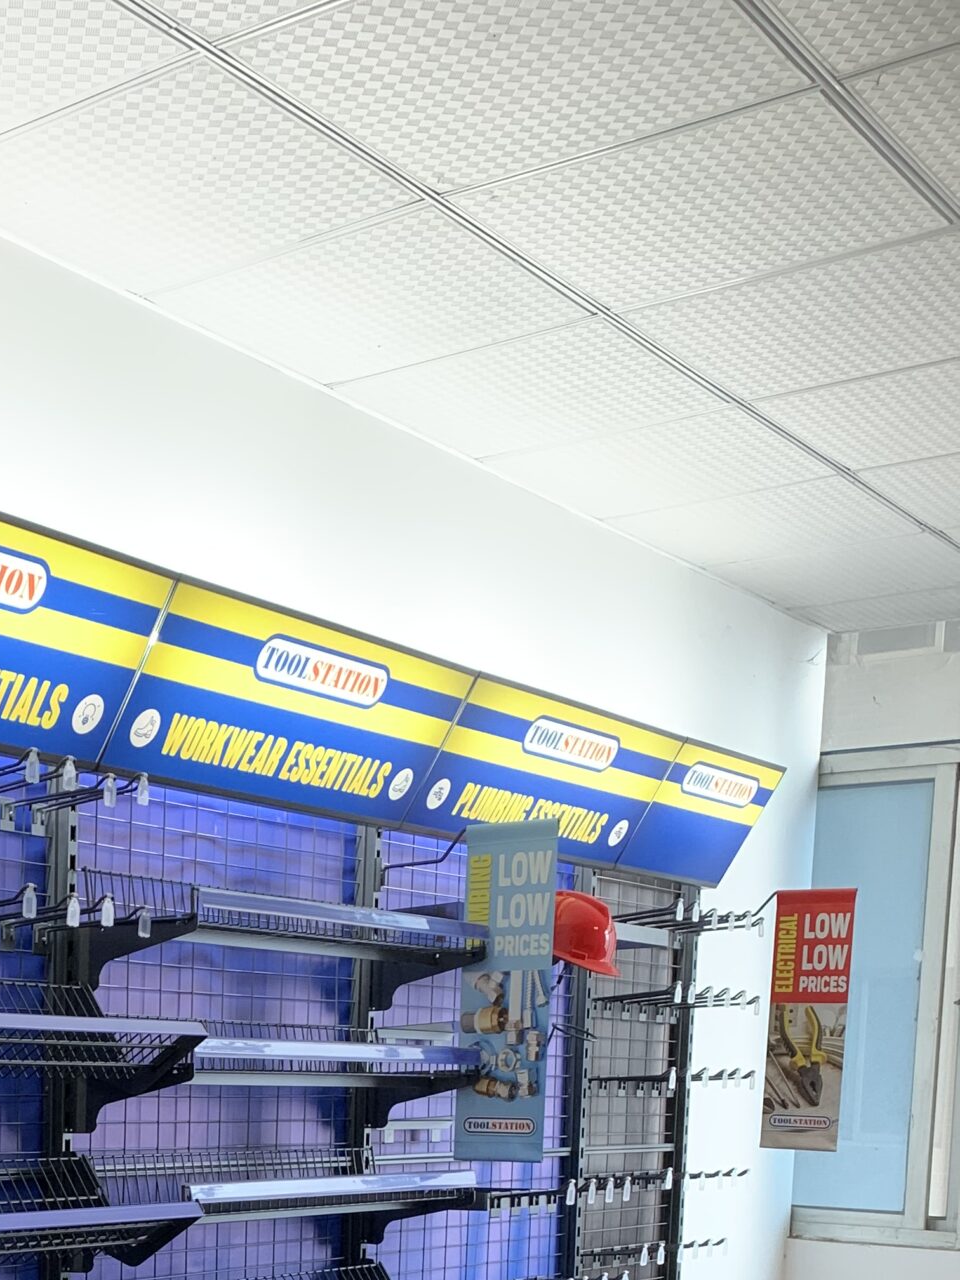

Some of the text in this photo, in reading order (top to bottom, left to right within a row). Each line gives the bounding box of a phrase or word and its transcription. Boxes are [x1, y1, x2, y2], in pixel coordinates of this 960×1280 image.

[262, 646, 384, 699] TOOLSTATION
[161, 712, 393, 798] WORKWEAR ESSENTIALS
[528, 723, 616, 764] TOOLSTATION
[687, 769, 755, 801] TOOLSTATION
[498, 850, 552, 887] LOW
[496, 892, 551, 928] LOW
[803, 912, 851, 939] LOW
[494, 933, 550, 957] PRICES
[774, 913, 798, 993] ELECTRICAL
[801, 944, 848, 971] LOW
[798, 975, 847, 993] PRICES
[466, 1121, 532, 1131] TOOLSTATION
[772, 1117, 828, 1127] TOOLSTATION
